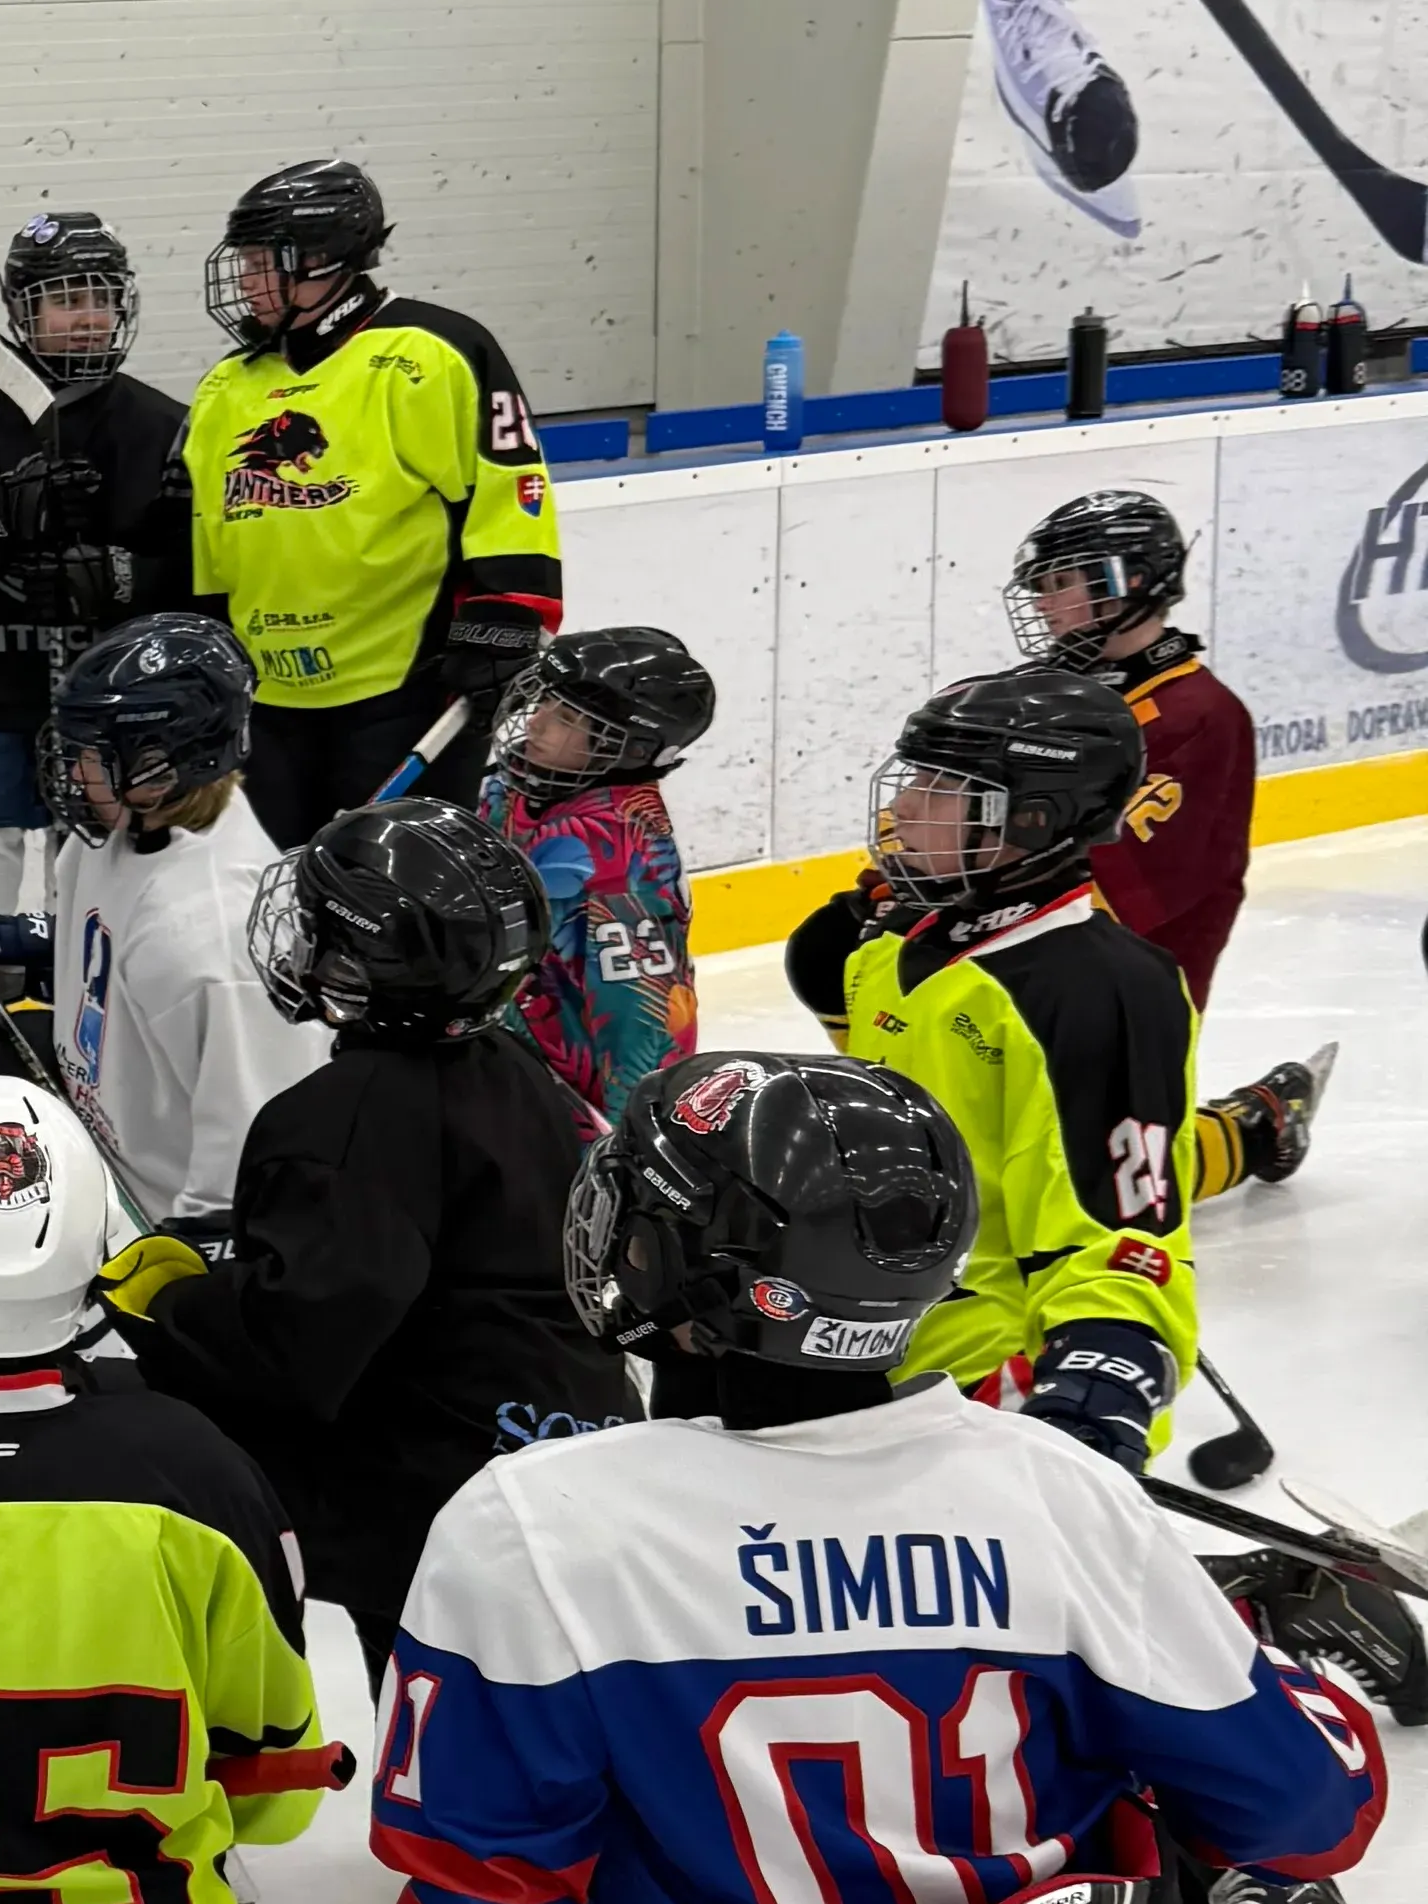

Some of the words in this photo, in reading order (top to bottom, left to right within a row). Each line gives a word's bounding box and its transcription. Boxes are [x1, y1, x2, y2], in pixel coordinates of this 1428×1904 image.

[1257, 715, 1328, 760] ÝROBA
[595, 919, 675, 983] 23
[643, 1166, 692, 1211] BAUER
[616, 1320, 660, 1345] BAUER
[737, 1520, 1013, 1638] ŠIMON
